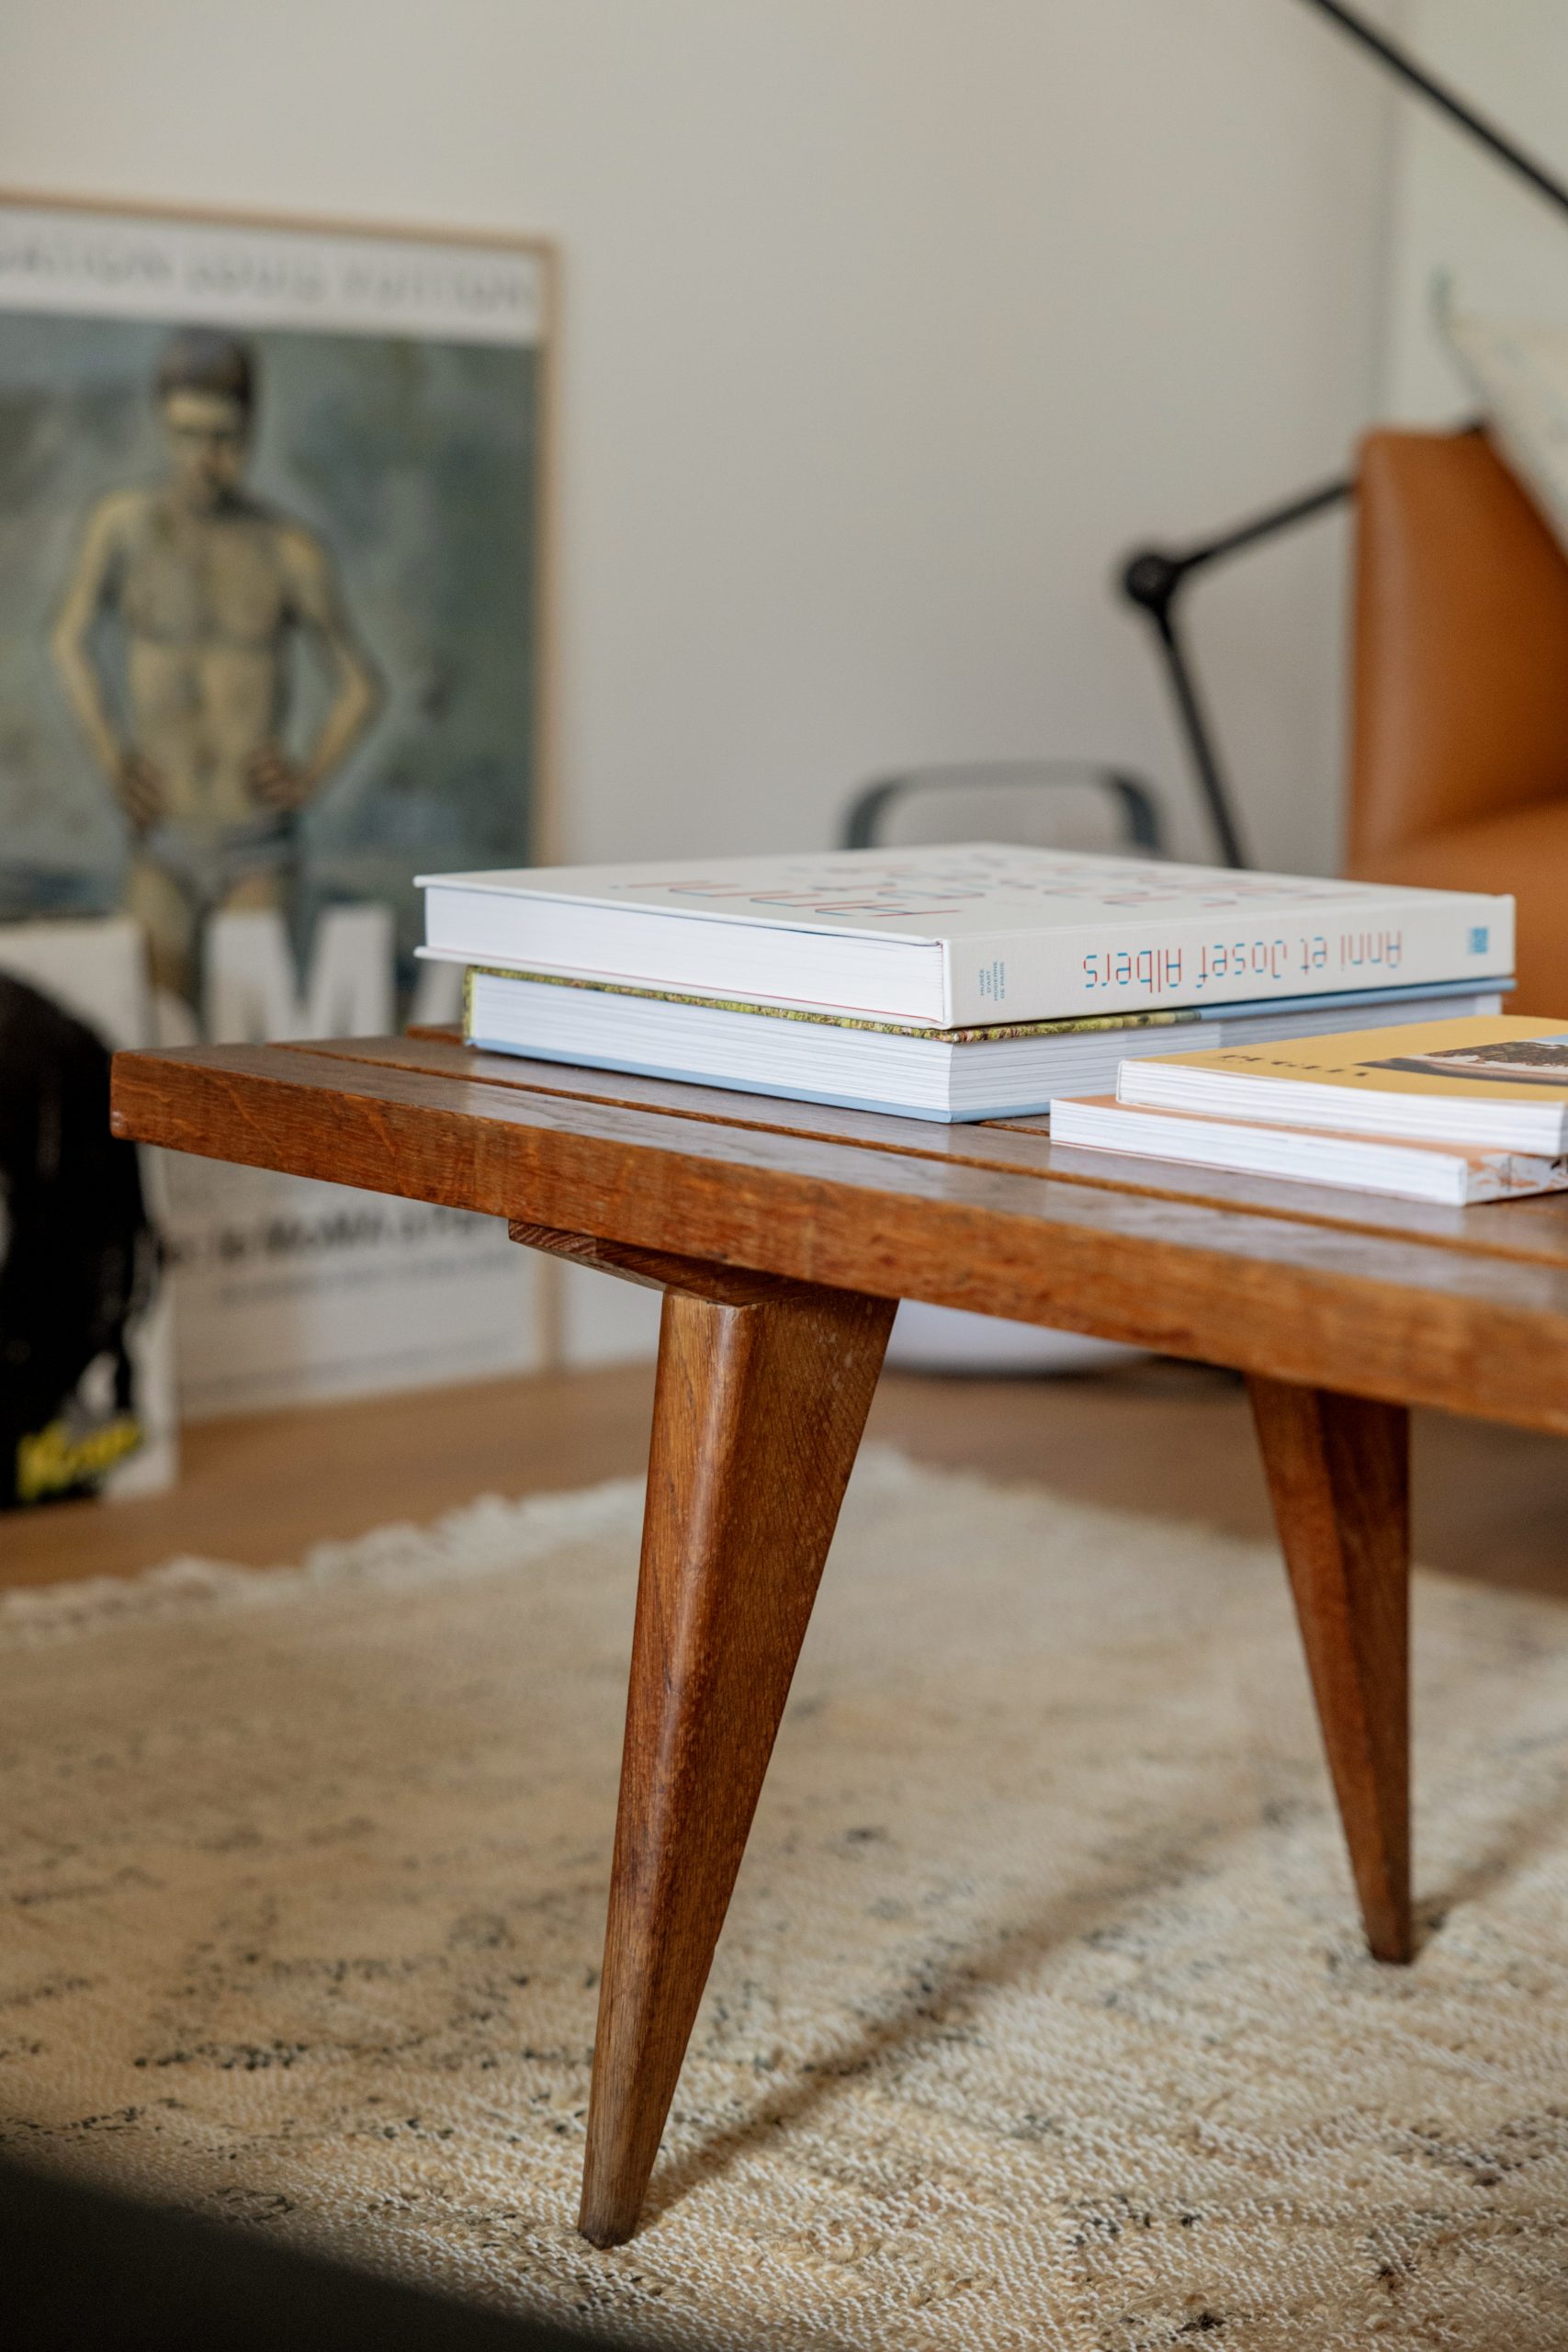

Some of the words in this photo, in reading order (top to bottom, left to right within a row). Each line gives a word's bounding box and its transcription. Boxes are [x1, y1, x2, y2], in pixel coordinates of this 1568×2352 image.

[1082, 948, 1182, 994] Albers
[1195, 940, 1288, 989] Josef
[1300, 936, 1328, 977] et
[1340, 930, 1403, 972] Anni
